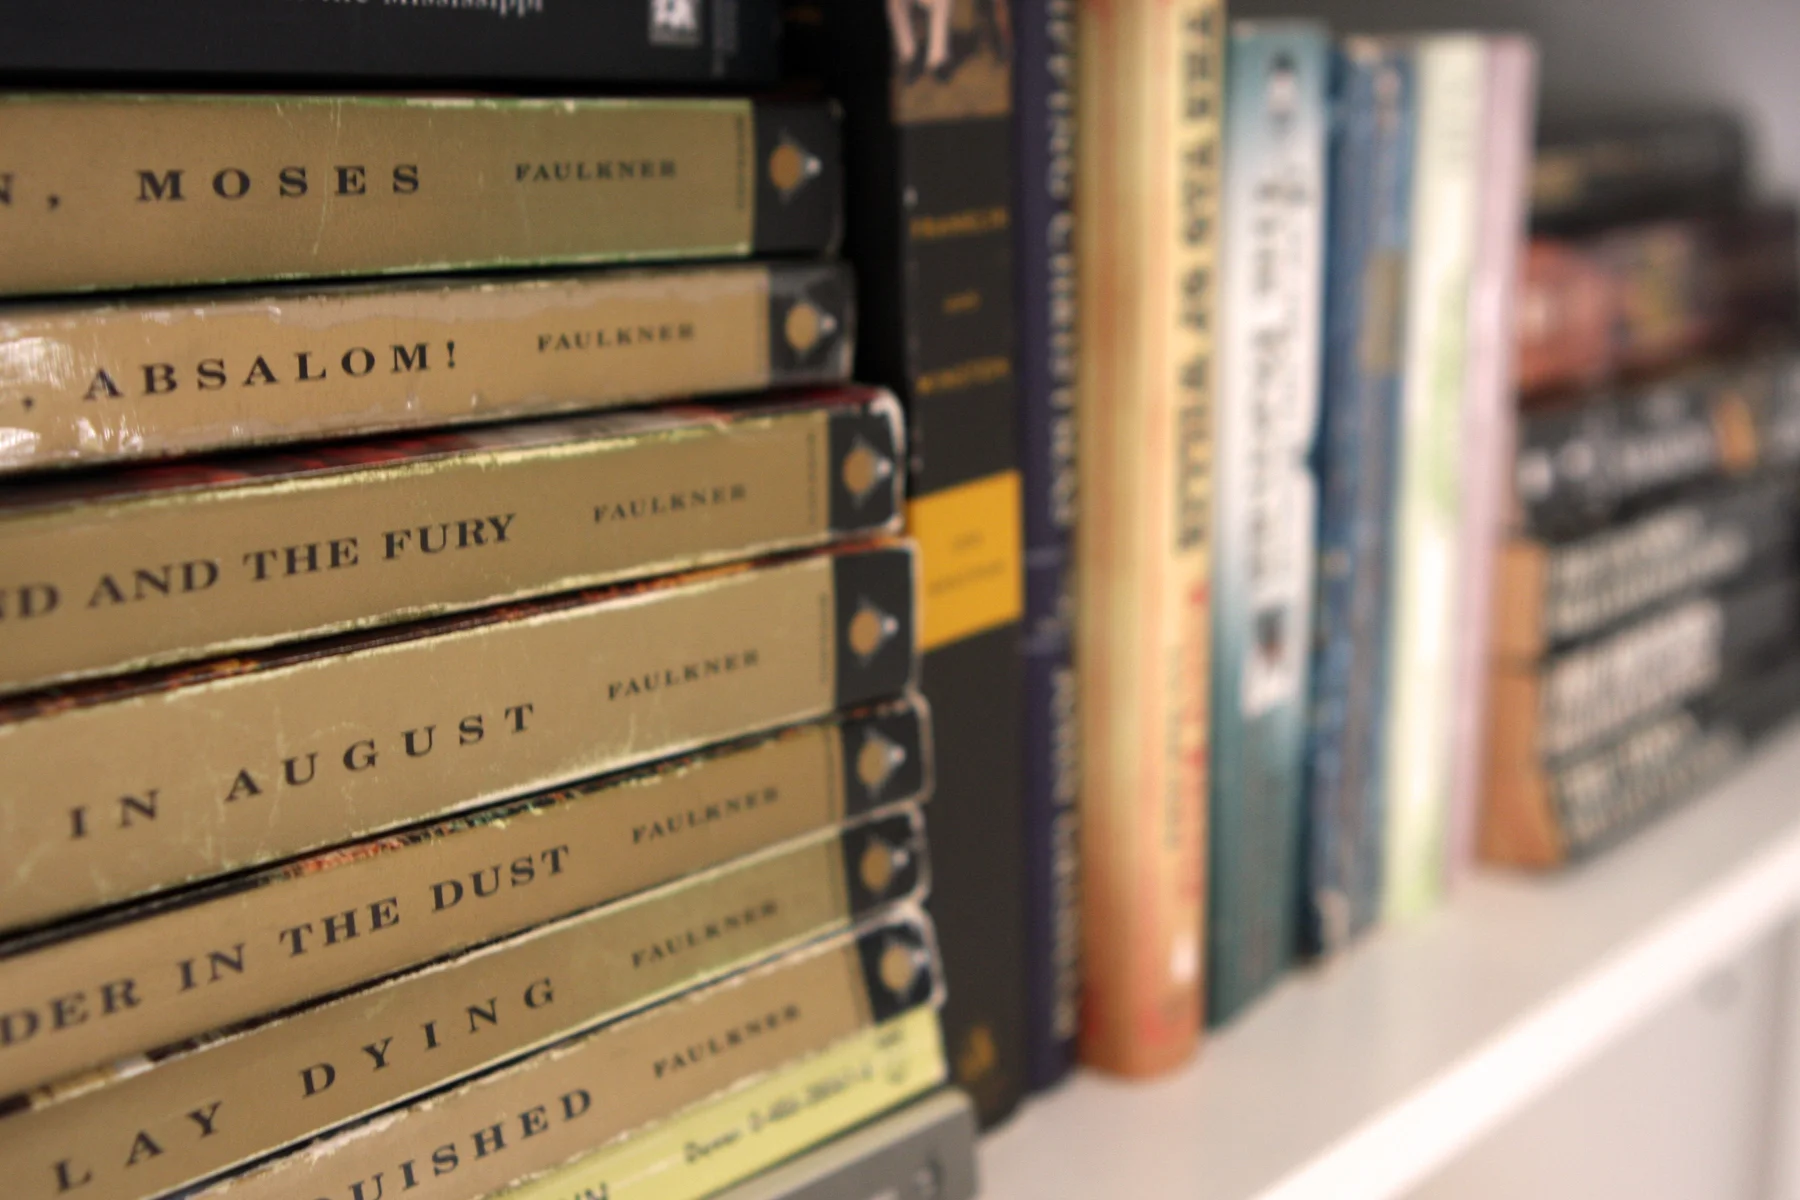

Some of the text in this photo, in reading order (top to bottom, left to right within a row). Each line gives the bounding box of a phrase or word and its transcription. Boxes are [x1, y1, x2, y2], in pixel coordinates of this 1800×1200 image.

[136, 164, 422, 202] MOSES
[515, 158, 677, 182] FAULKNER
[83, 340, 459, 401] ABSALOM!
[537, 322, 696, 353] FAULKNER
[88, 560, 220, 609] AND
[243, 537, 360, 581] THE
[384, 512, 517, 562] FURY
[594, 483, 747, 524] FAULKNER
[69, 647, 760, 840] IN AUGUST FAULKNER
[0, 785, 780, 1048] DER IN THE DUST FAULKNER
[51, 898, 780, 1194] LAY DYING FAULKNER
[312, 1004, 801, 1200] UISHED FAULKNER
